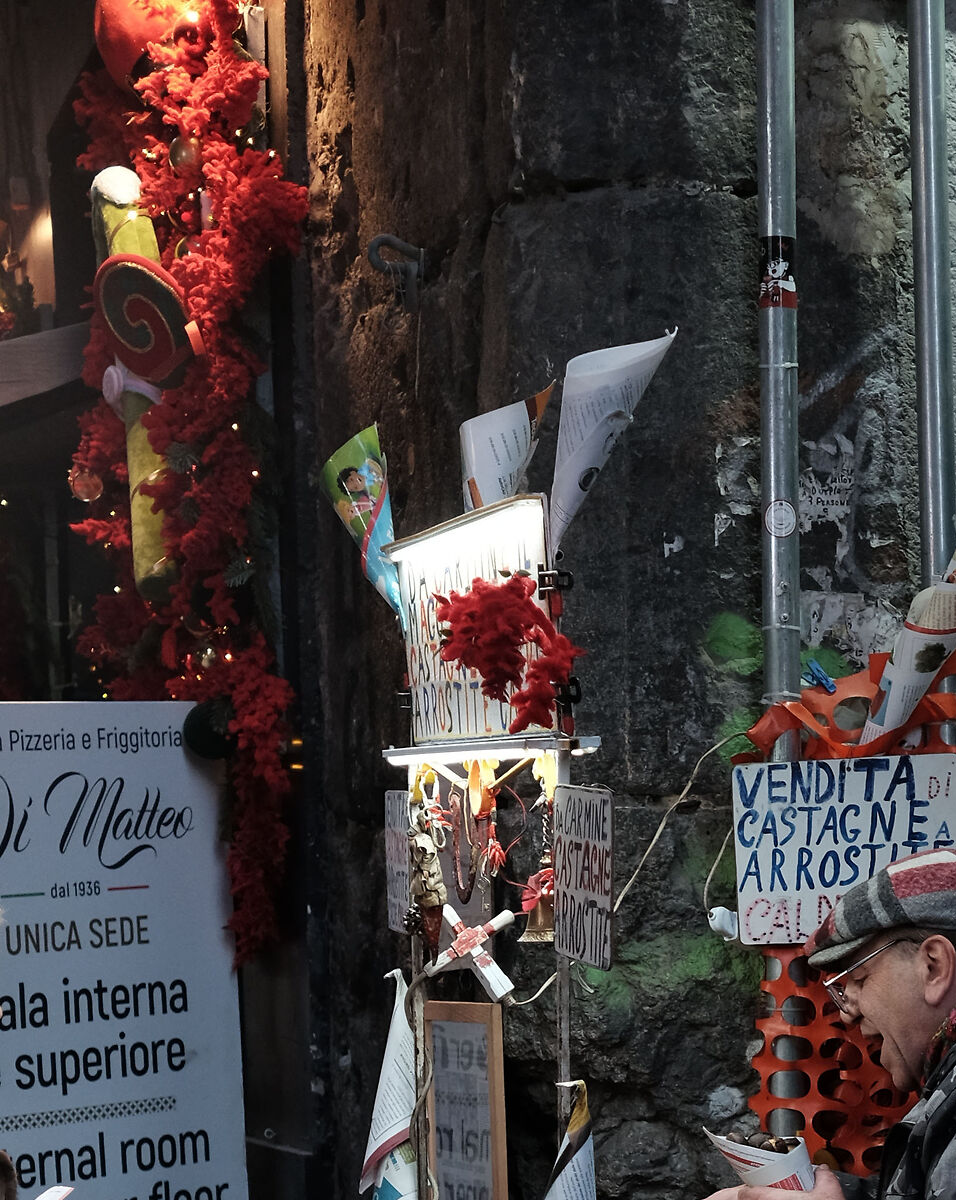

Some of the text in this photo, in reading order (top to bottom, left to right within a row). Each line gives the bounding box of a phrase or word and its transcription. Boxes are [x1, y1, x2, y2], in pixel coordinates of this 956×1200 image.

[9, 728, 75, 751] Pizzeria
[82, 732, 91, 750] e
[97, 725, 182, 753] Friggitoria
[735, 755, 917, 809] VENDITA
[44, 771, 195, 869] Matteo
[564, 793, 609, 842] CARMINE
[736, 800, 930, 849] CASTAGNE
[51, 880, 101, 899] dal 1936
[554, 834, 611, 897] CASTAGNE
[5, 915, 149, 955] UNICA SEDE
[62, 977, 189, 1025] interna
[15, 1031, 187, 1096] superiore
[10, 1129, 210, 1188] ernal room
